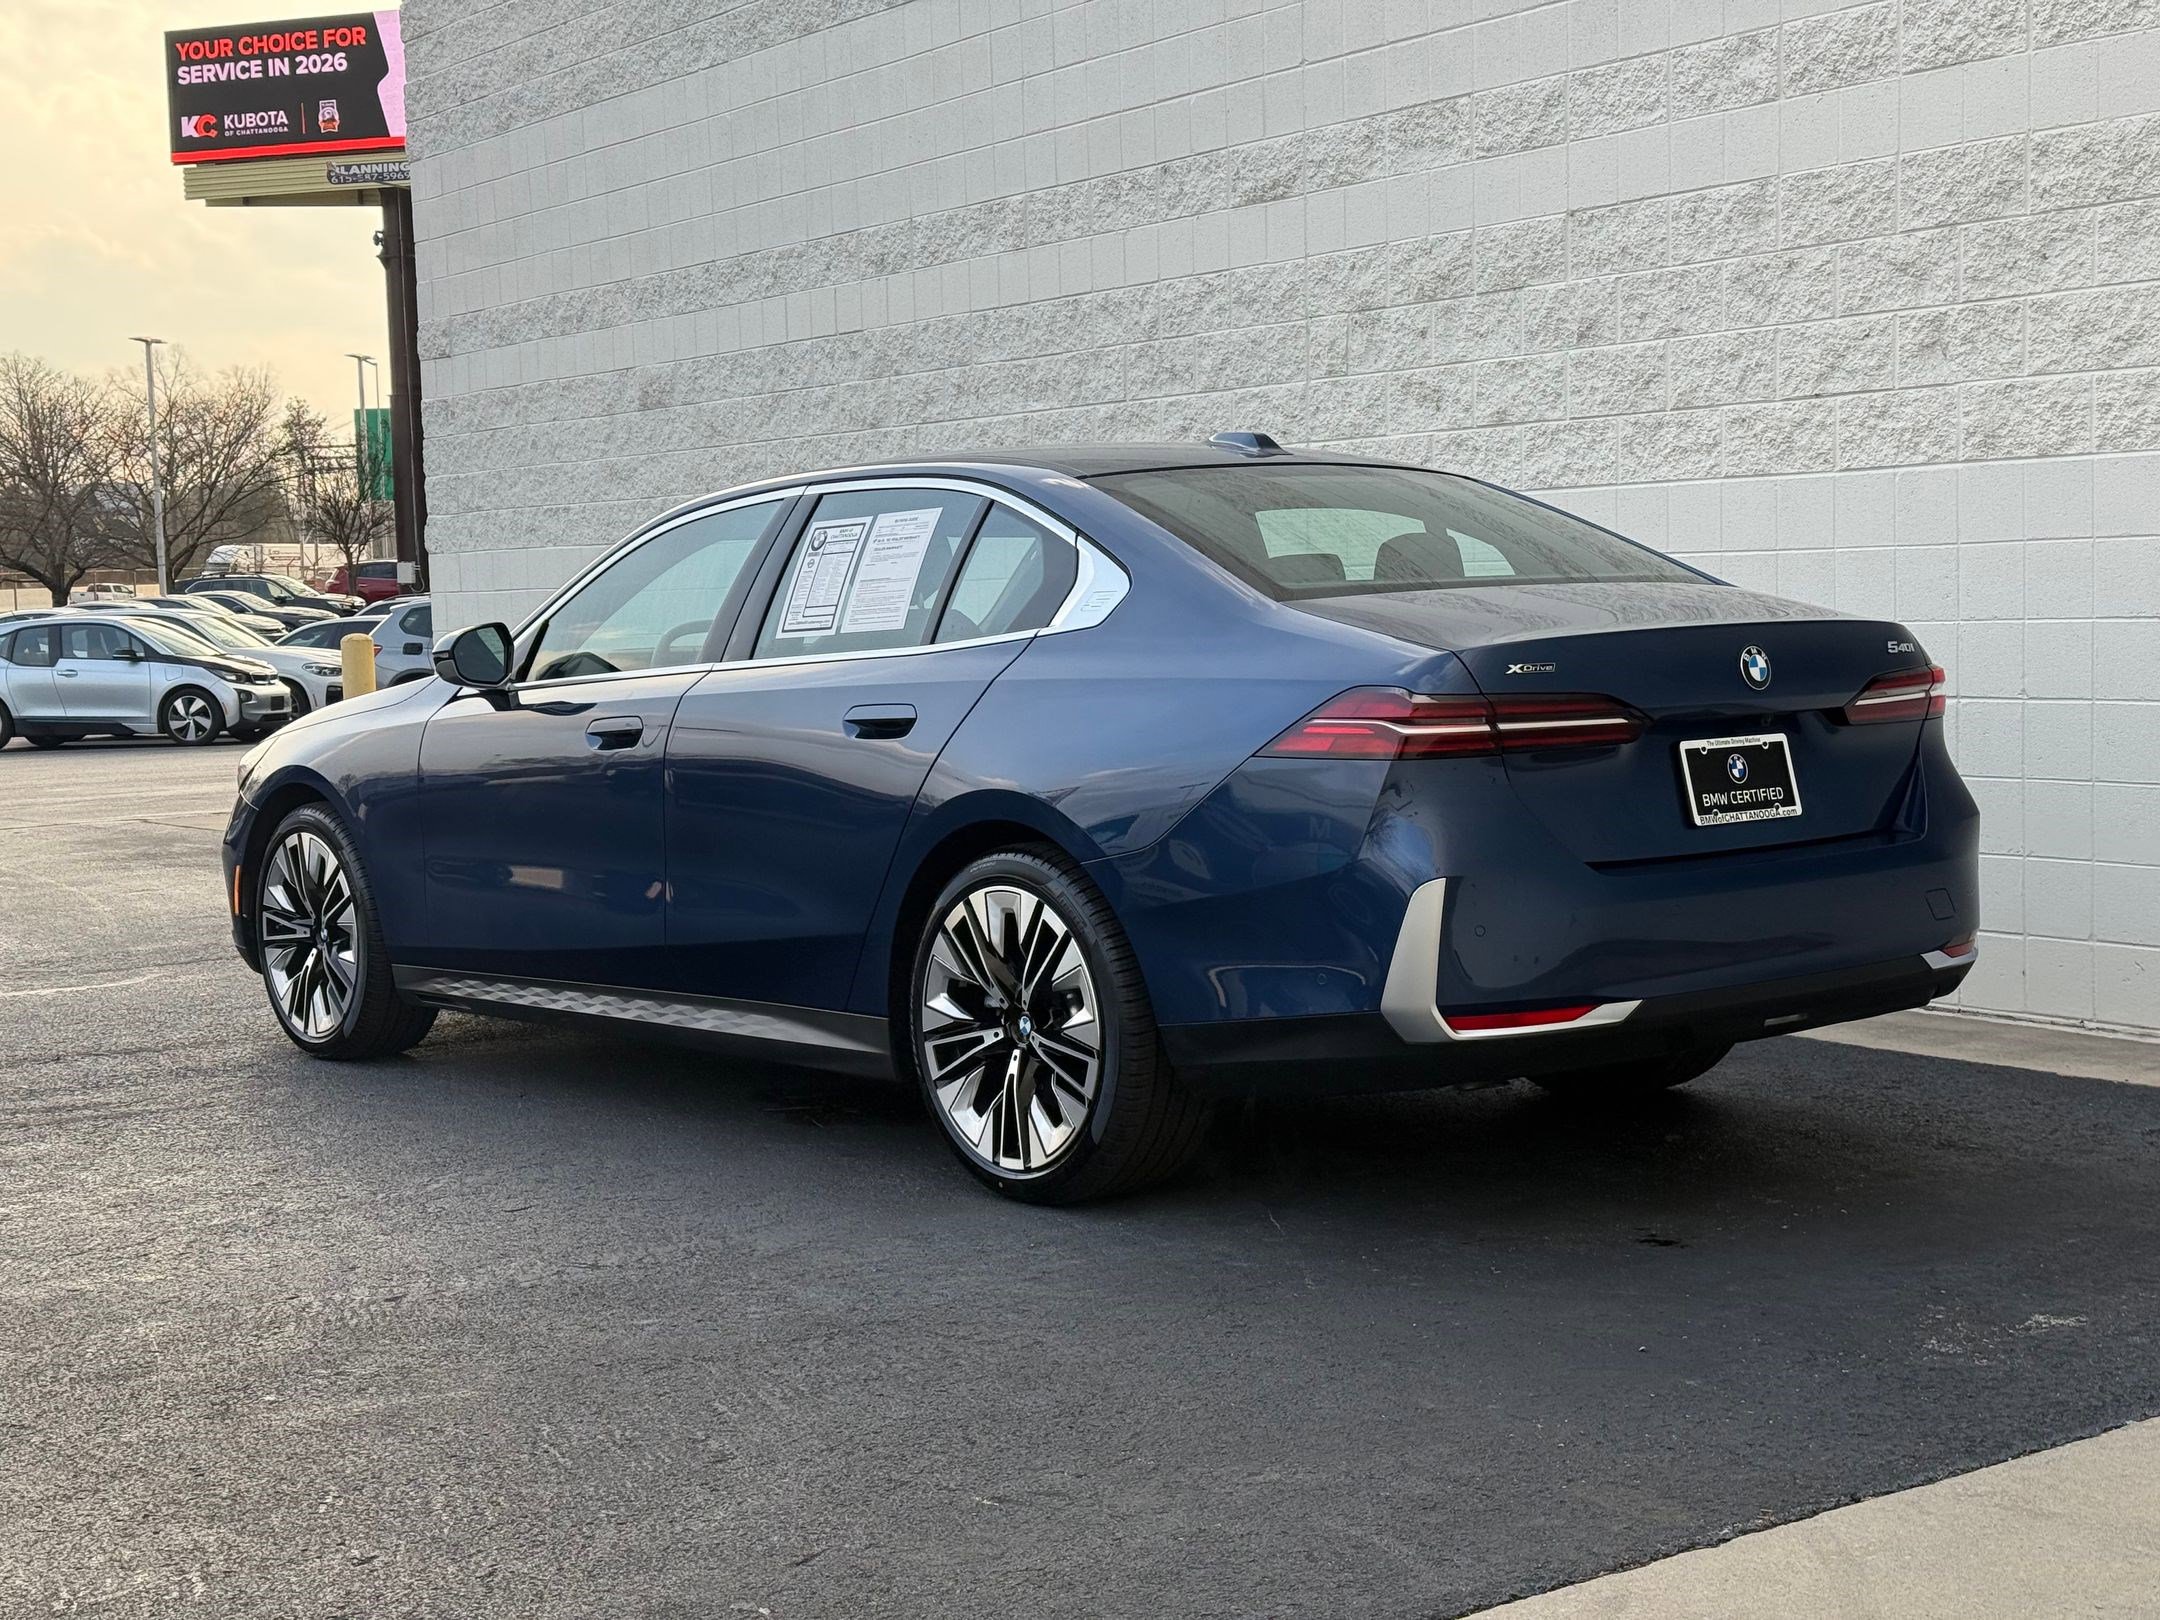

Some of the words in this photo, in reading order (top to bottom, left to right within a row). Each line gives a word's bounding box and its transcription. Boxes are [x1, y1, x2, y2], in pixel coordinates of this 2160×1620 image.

[176, 38, 234, 61] YOUR
[238, 30, 318, 55] CHOICE
[323, 26, 366, 48] FOR
[177, 60, 263, 85] SERVICE
[268, 57, 290, 76] IN
[295, 52, 348, 75] 2026
[223, 110, 289, 129] KUBOTA
[236, 126, 289, 137] CHATTANOOGA
[1702, 792, 1728, 807] BMW
[1730, 787, 1784, 804] CERTIFIED
